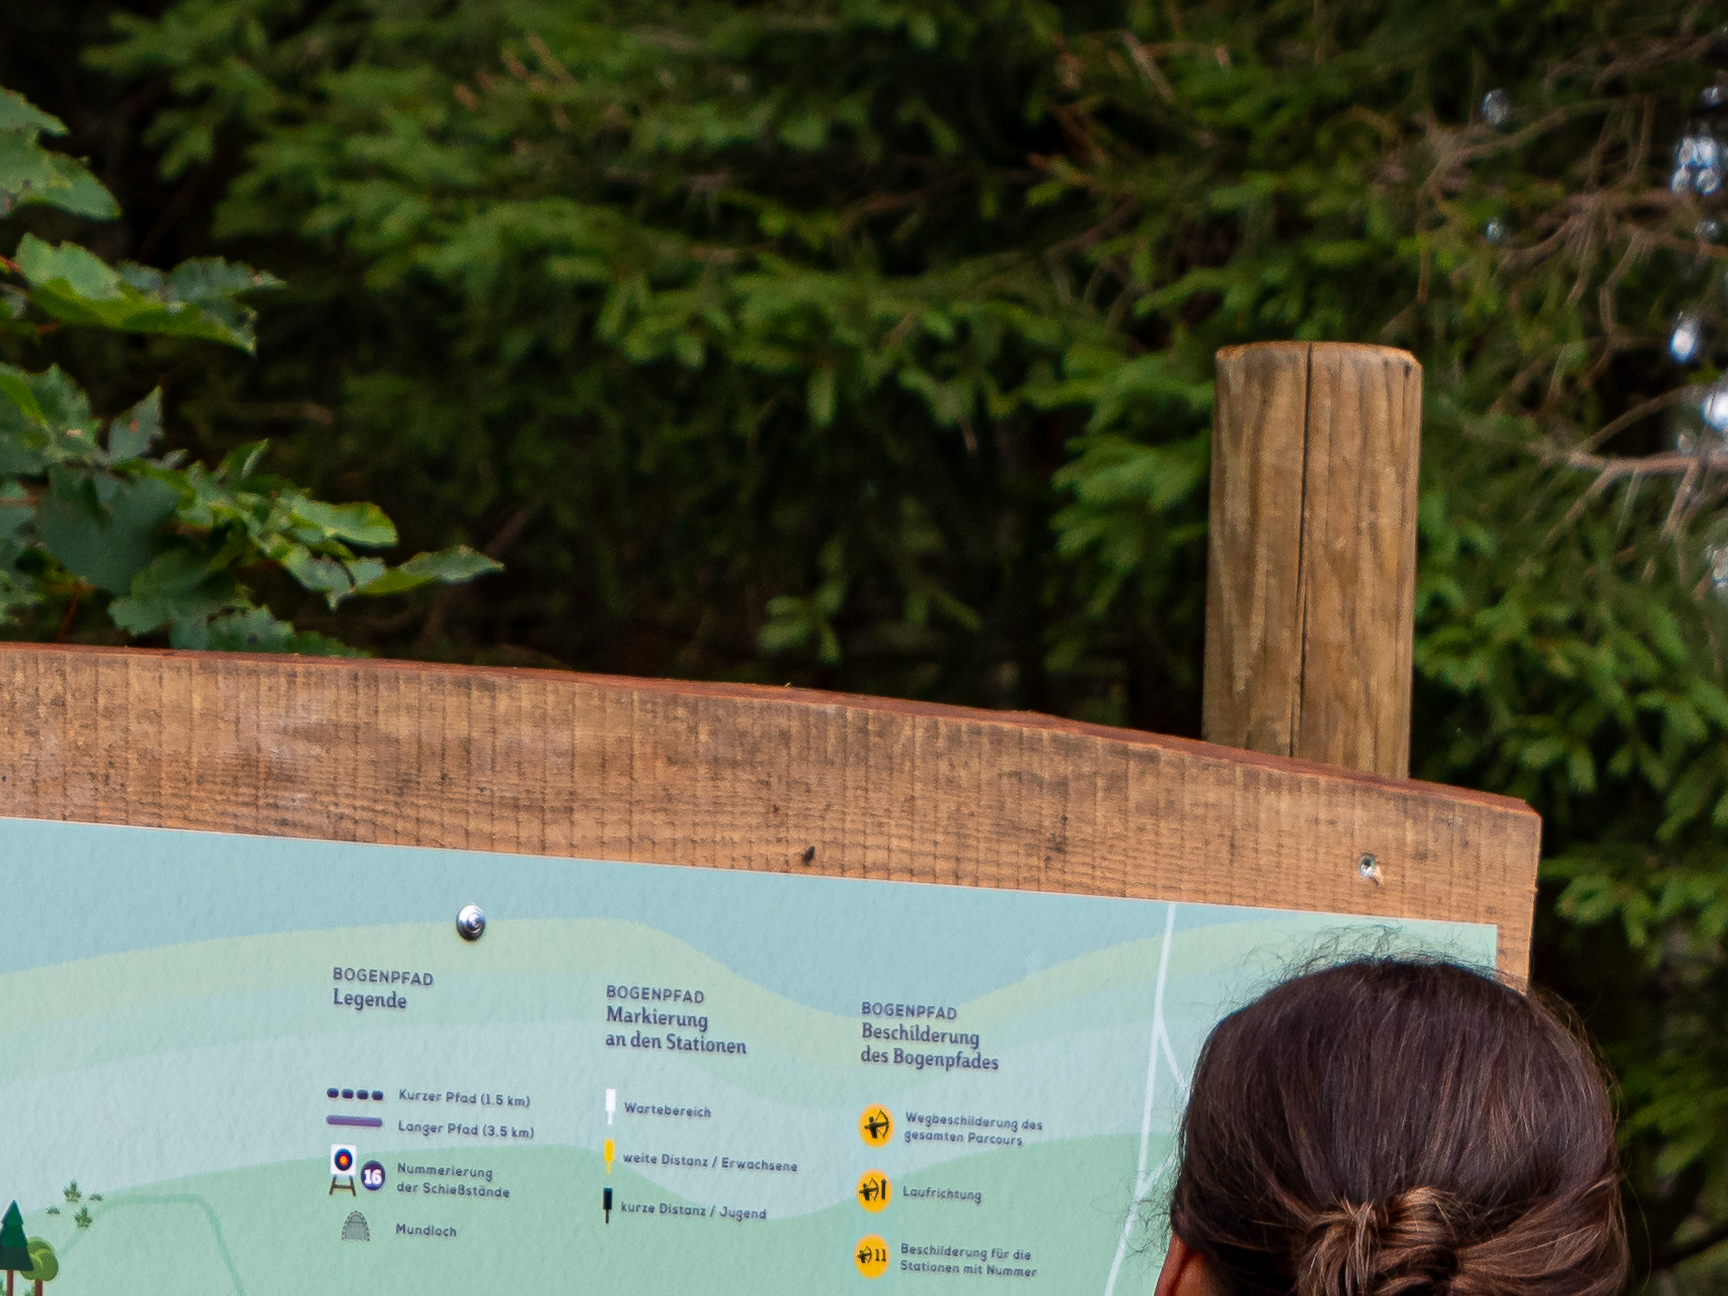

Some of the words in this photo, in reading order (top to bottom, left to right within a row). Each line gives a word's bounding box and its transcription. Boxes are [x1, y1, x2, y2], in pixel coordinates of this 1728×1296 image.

[333, 967, 434, 986] BOGENPFAD
[333, 988, 407, 1011] Legende
[606, 984, 705, 1004] BOGENPFAD
[606, 1005, 709, 1033] Markierung
[861, 1001, 957, 1020] BOGENPFAD
[605, 1033, 627, 1047] an
[630, 1030, 662, 1049] den
[666, 1033, 747, 1055] Stationen
[862, 1021, 980, 1050] Beschilderung
[860, 1045, 889, 1063] des
[893, 1047, 999, 1072] Bogenpfades
[399, 1088, 442, 1102] Kurzer
[445, 1091, 477, 1104] Pfad
[507, 1095, 531, 1108] km)
[624, 1101, 712, 1118] Wartebereich
[398, 1120, 444, 1137] Langer
[447, 1122, 479, 1136] Pfad
[511, 1126, 535, 1140] km)
[905, 1111, 1018, 1133] Wegbeschilderung
[1021, 1119, 1043, 1131] des
[904, 1130, 964, 1144] gesamten
[967, 1131, 1023, 1147] Parcours
[622, 1152, 657, 1164] weite
[661, 1153, 708, 1167] Distanz
[721, 1157, 798, 1172] Erwachsene
[364, 1168, 382, 1185] 16
[397, 1162, 493, 1183] Nummerierung
[397, 1181, 418, 1193] der
[422, 1182, 510, 1199] Schießstände
[902, 1185, 982, 1205] Laufrichtung
[620, 1201, 655, 1214] kurze
[659, 1202, 706, 1217] Distanz
[719, 1206, 767, 1222] Jugend
[395, 1223, 458, 1237] Mundloch
[900, 1243, 987, 1262] Beschilderung
[990, 1247, 1010, 1260] für
[1013, 1248, 1032, 1261] die
[900, 1260, 960, 1273] Stationen
[963, 1263, 983, 1275] mit
[986, 1264, 1038, 1277] Nummer
